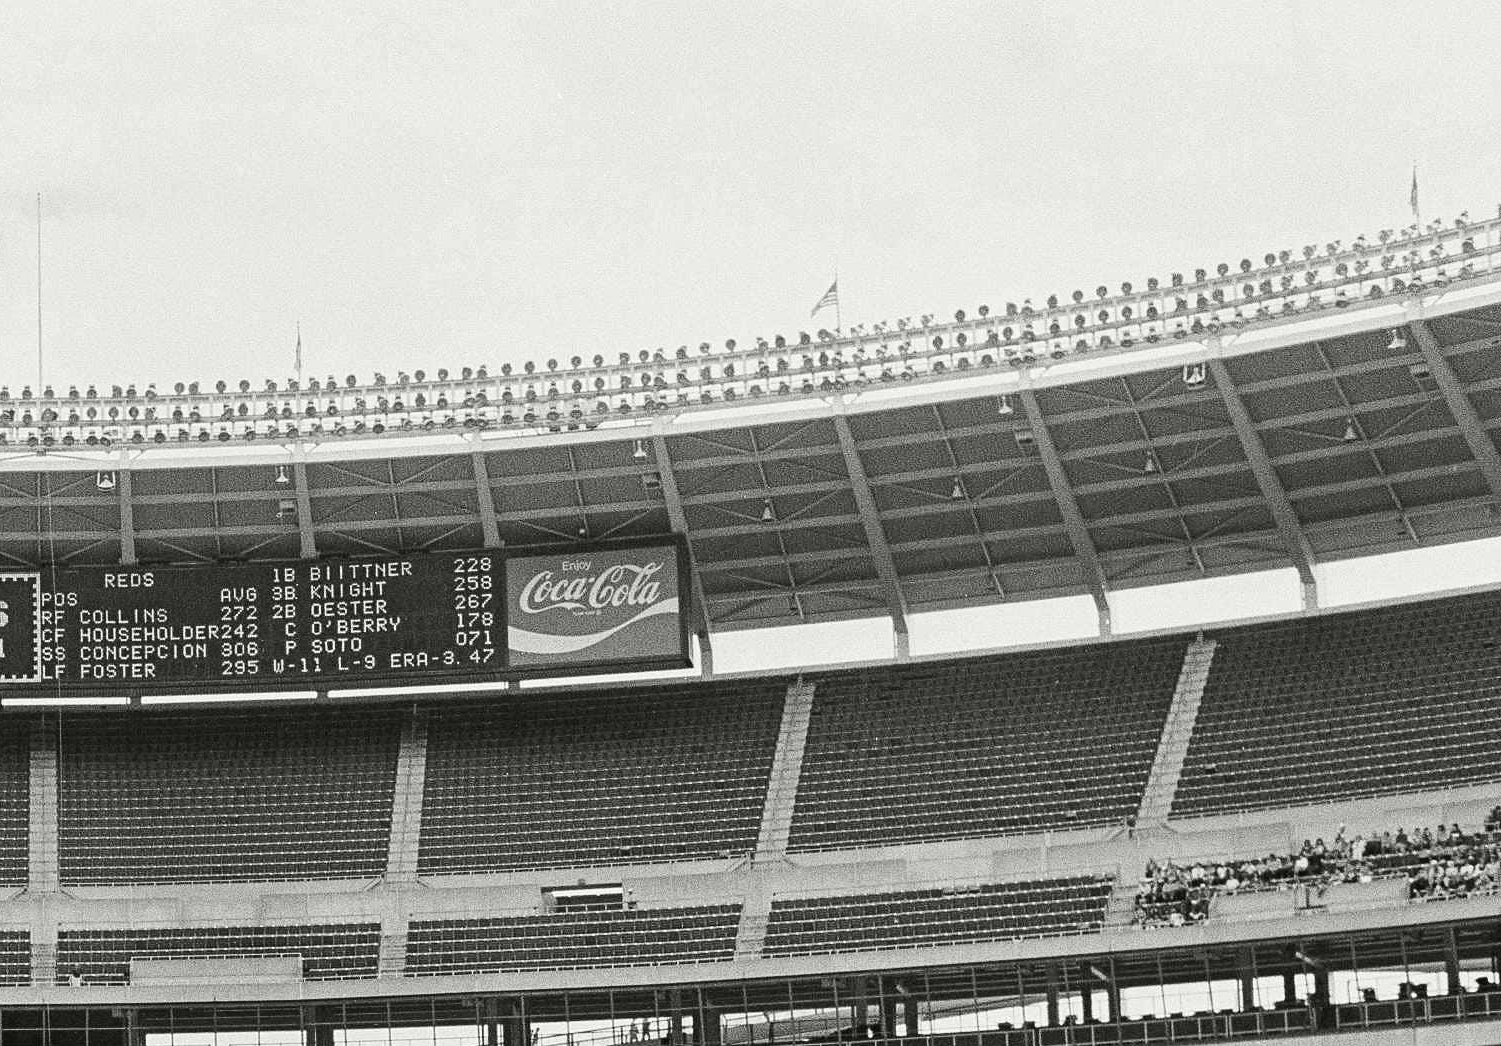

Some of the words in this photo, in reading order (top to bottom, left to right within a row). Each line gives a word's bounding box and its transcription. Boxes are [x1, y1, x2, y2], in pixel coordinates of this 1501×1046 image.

[272, 567, 296, 583] 1B
[453, 557, 492, 573] 228
[562, 560, 591, 571] Enjoy
[104, 572, 155, 588] REDS
[310, 580, 387, 599] KNIGHT
[453, 575, 493, 591] 258
[519, 562, 664, 614] Coca-Cola
[41, 592, 78, 607] POS
[220, 587, 257, 603] AVG
[271, 604, 297, 619] 2B
[310, 599, 388, 617] OESTER
[454, 593, 493, 609] 267
[41, 610, 65, 625] RF
[79, 608, 169, 624] COLLINS
[220, 605, 258, 621] 272
[285, 622, 297, 637] C
[311, 616, 401, 635] O'BERRY
[456, 612, 494, 628] 178
[41, 628, 66, 643] CF
[79, 625, 220, 643] HOUSEHOLDER
[220, 623, 258, 639] 242
[285, 640, 297, 656] P
[311, 637, 362, 654] SOTO
[455, 630, 492, 646] 071
[41, 646, 66, 661] SS
[79, 643, 208, 661] CONCEPCION
[220, 641, 259, 657] 306
[41, 664, 66, 680] LF
[80, 663, 156, 679] FOSTER
[221, 660, 260, 675] 295
[273, 657, 322, 674] W-11
[338, 654, 376, 671] L-9
